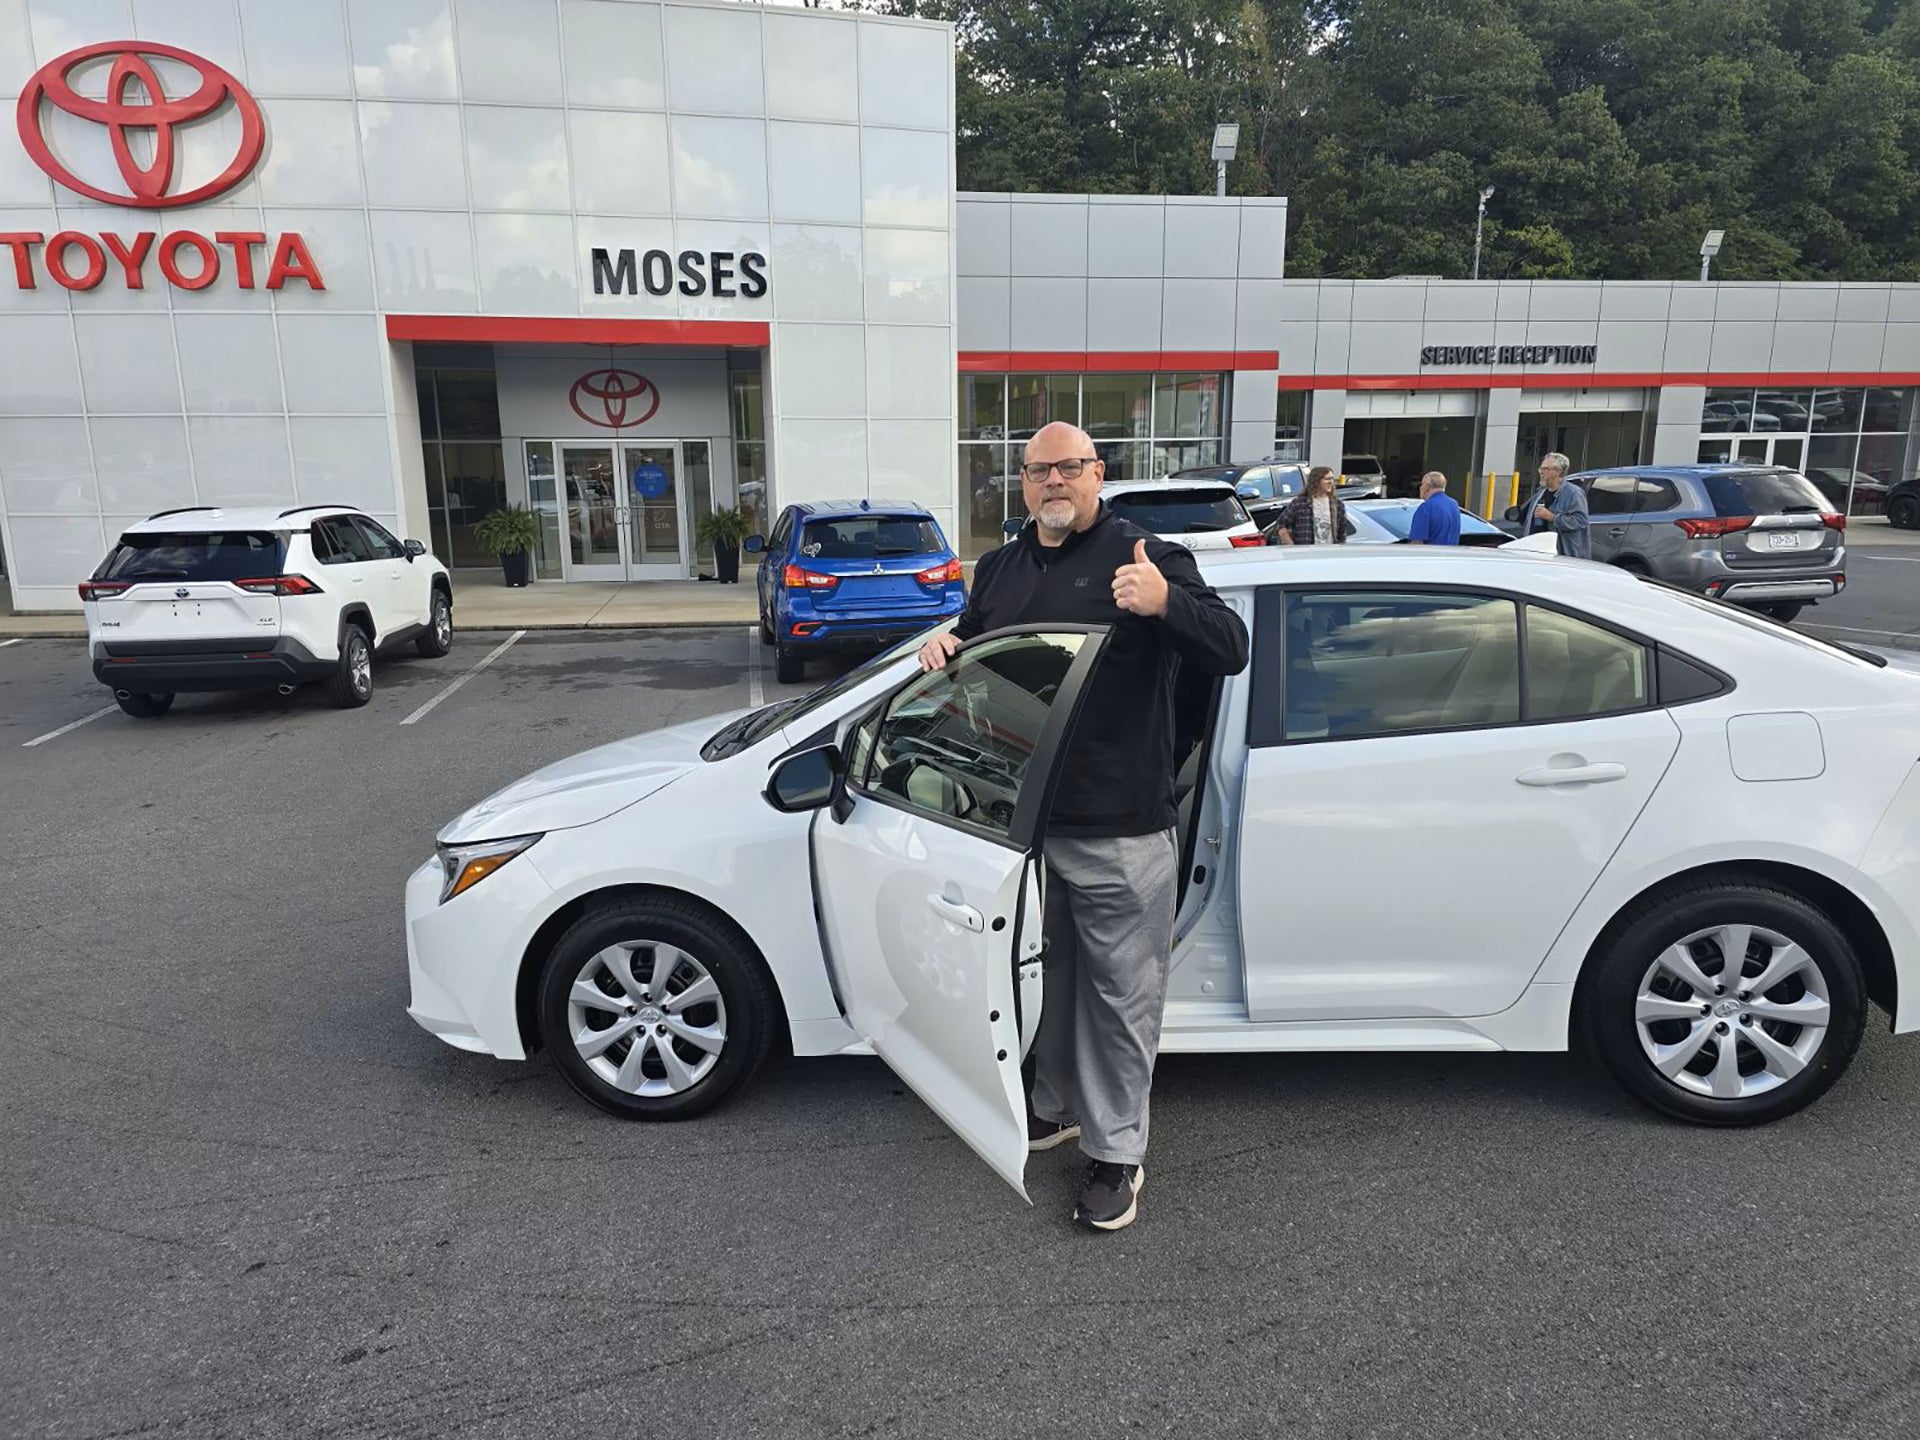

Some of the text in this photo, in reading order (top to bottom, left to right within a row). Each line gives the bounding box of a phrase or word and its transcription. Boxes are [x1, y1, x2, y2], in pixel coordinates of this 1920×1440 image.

[0, 230, 327, 291] TOYOTA
[591, 248, 767, 298] MOSES
[1421, 345, 1597, 365] SERVICE RECEPTION
